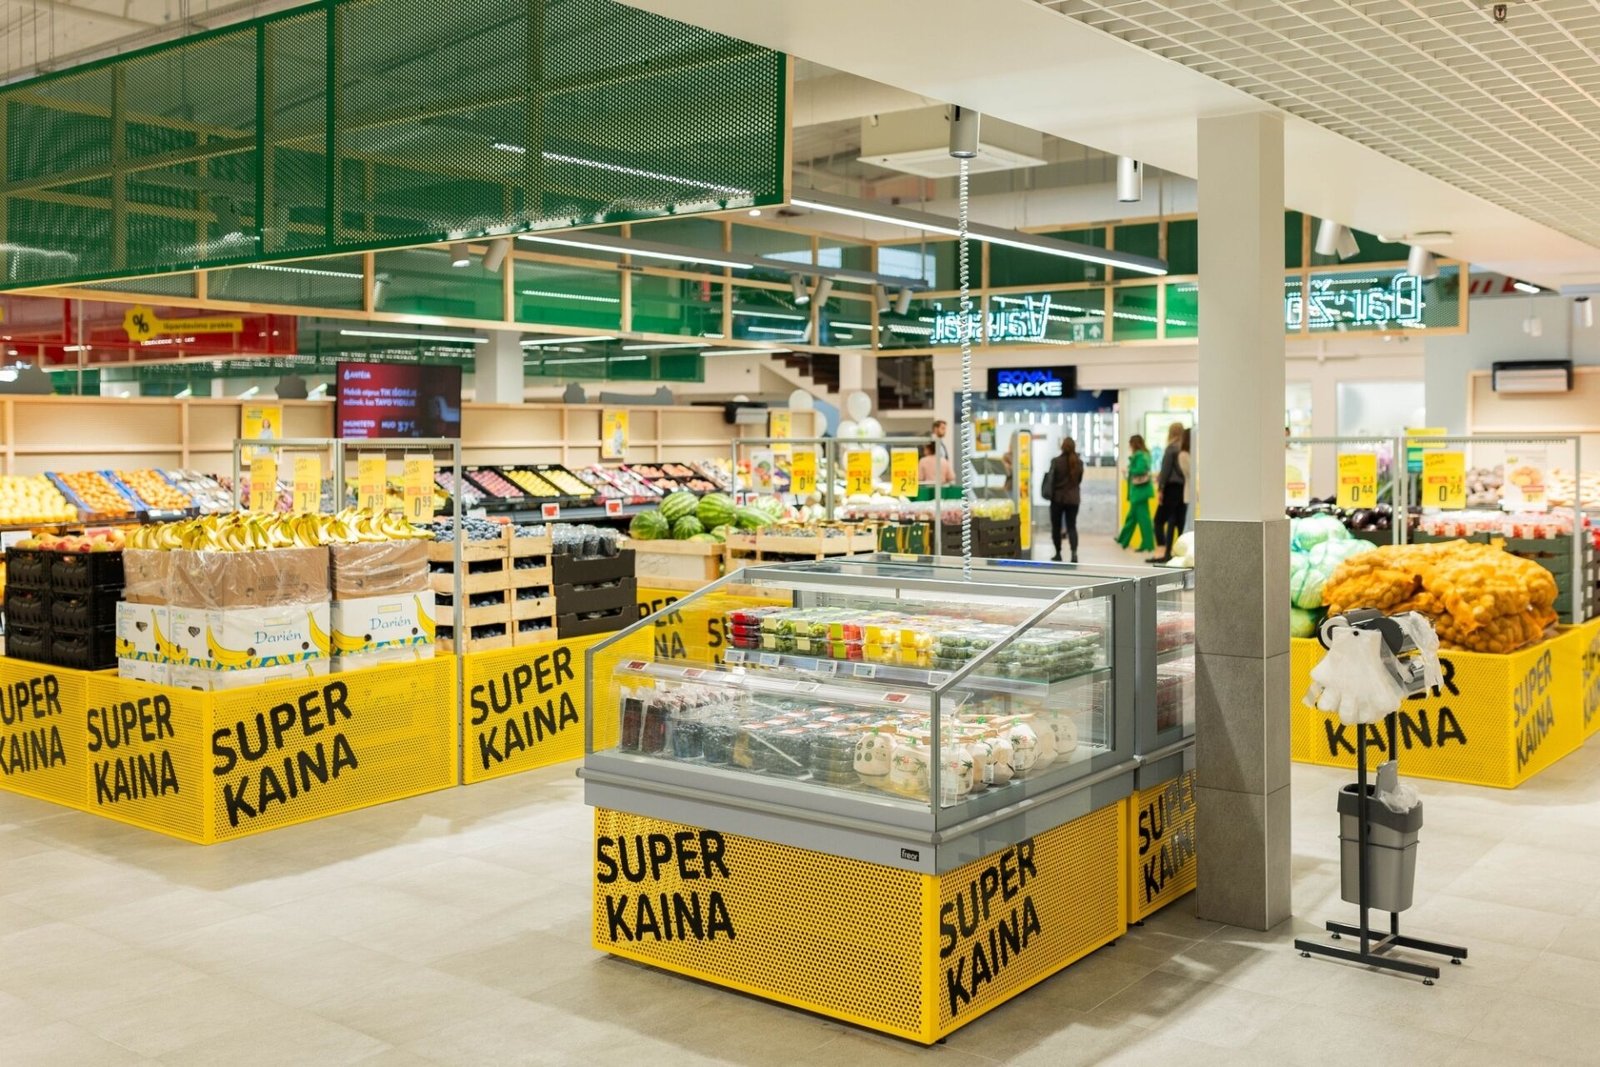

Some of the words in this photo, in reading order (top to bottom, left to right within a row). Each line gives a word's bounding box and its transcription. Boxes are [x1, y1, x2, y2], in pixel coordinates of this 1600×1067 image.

[998, 381, 1063, 397] SMOKE
[254, 630, 301, 644] Darién
[369, 614, 412, 630] Darién
[0, 674, 62, 725] UPER
[471, 647, 574, 725] SUPER
[1514, 648, 1553, 728] SUPER
[88, 694, 175, 752] SUPER
[212, 681, 352, 776] SUPER
[479, 692, 578, 770] KAINA
[1516, 695, 1555, 773] KAINA
[94, 750, 179, 805] KAINA
[223, 733, 358, 827] KAINA
[597, 830, 730, 883] SUPER
[901, 849, 919, 861] freor
[1144, 820, 1196, 904] KAIN
[606, 891, 736, 942] KAINA
[940, 838, 1037, 958] SUPER
[947, 895, 1041, 1017] KAINA
